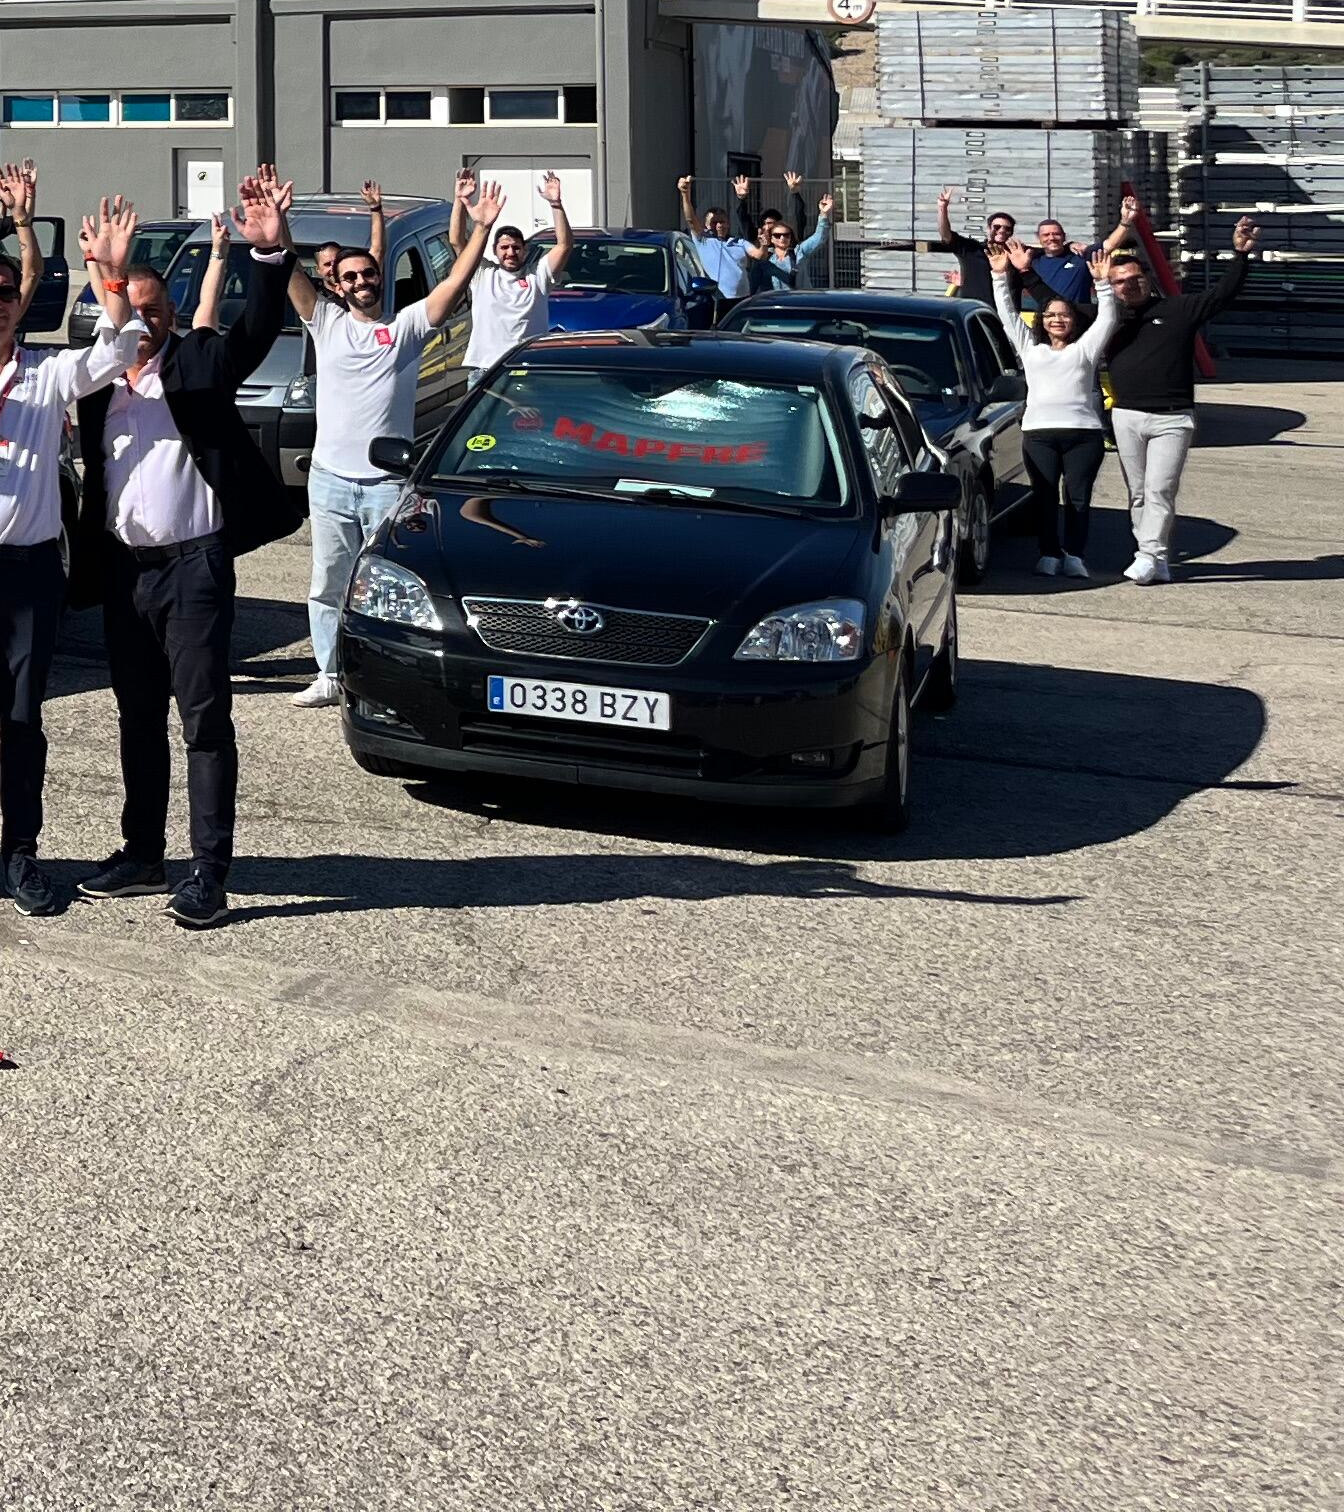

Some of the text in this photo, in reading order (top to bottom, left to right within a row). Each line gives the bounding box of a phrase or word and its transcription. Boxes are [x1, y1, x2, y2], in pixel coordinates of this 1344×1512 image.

[553, 416, 770, 465] MAPFRE
[510, 682, 659, 724] 0338 BZY
